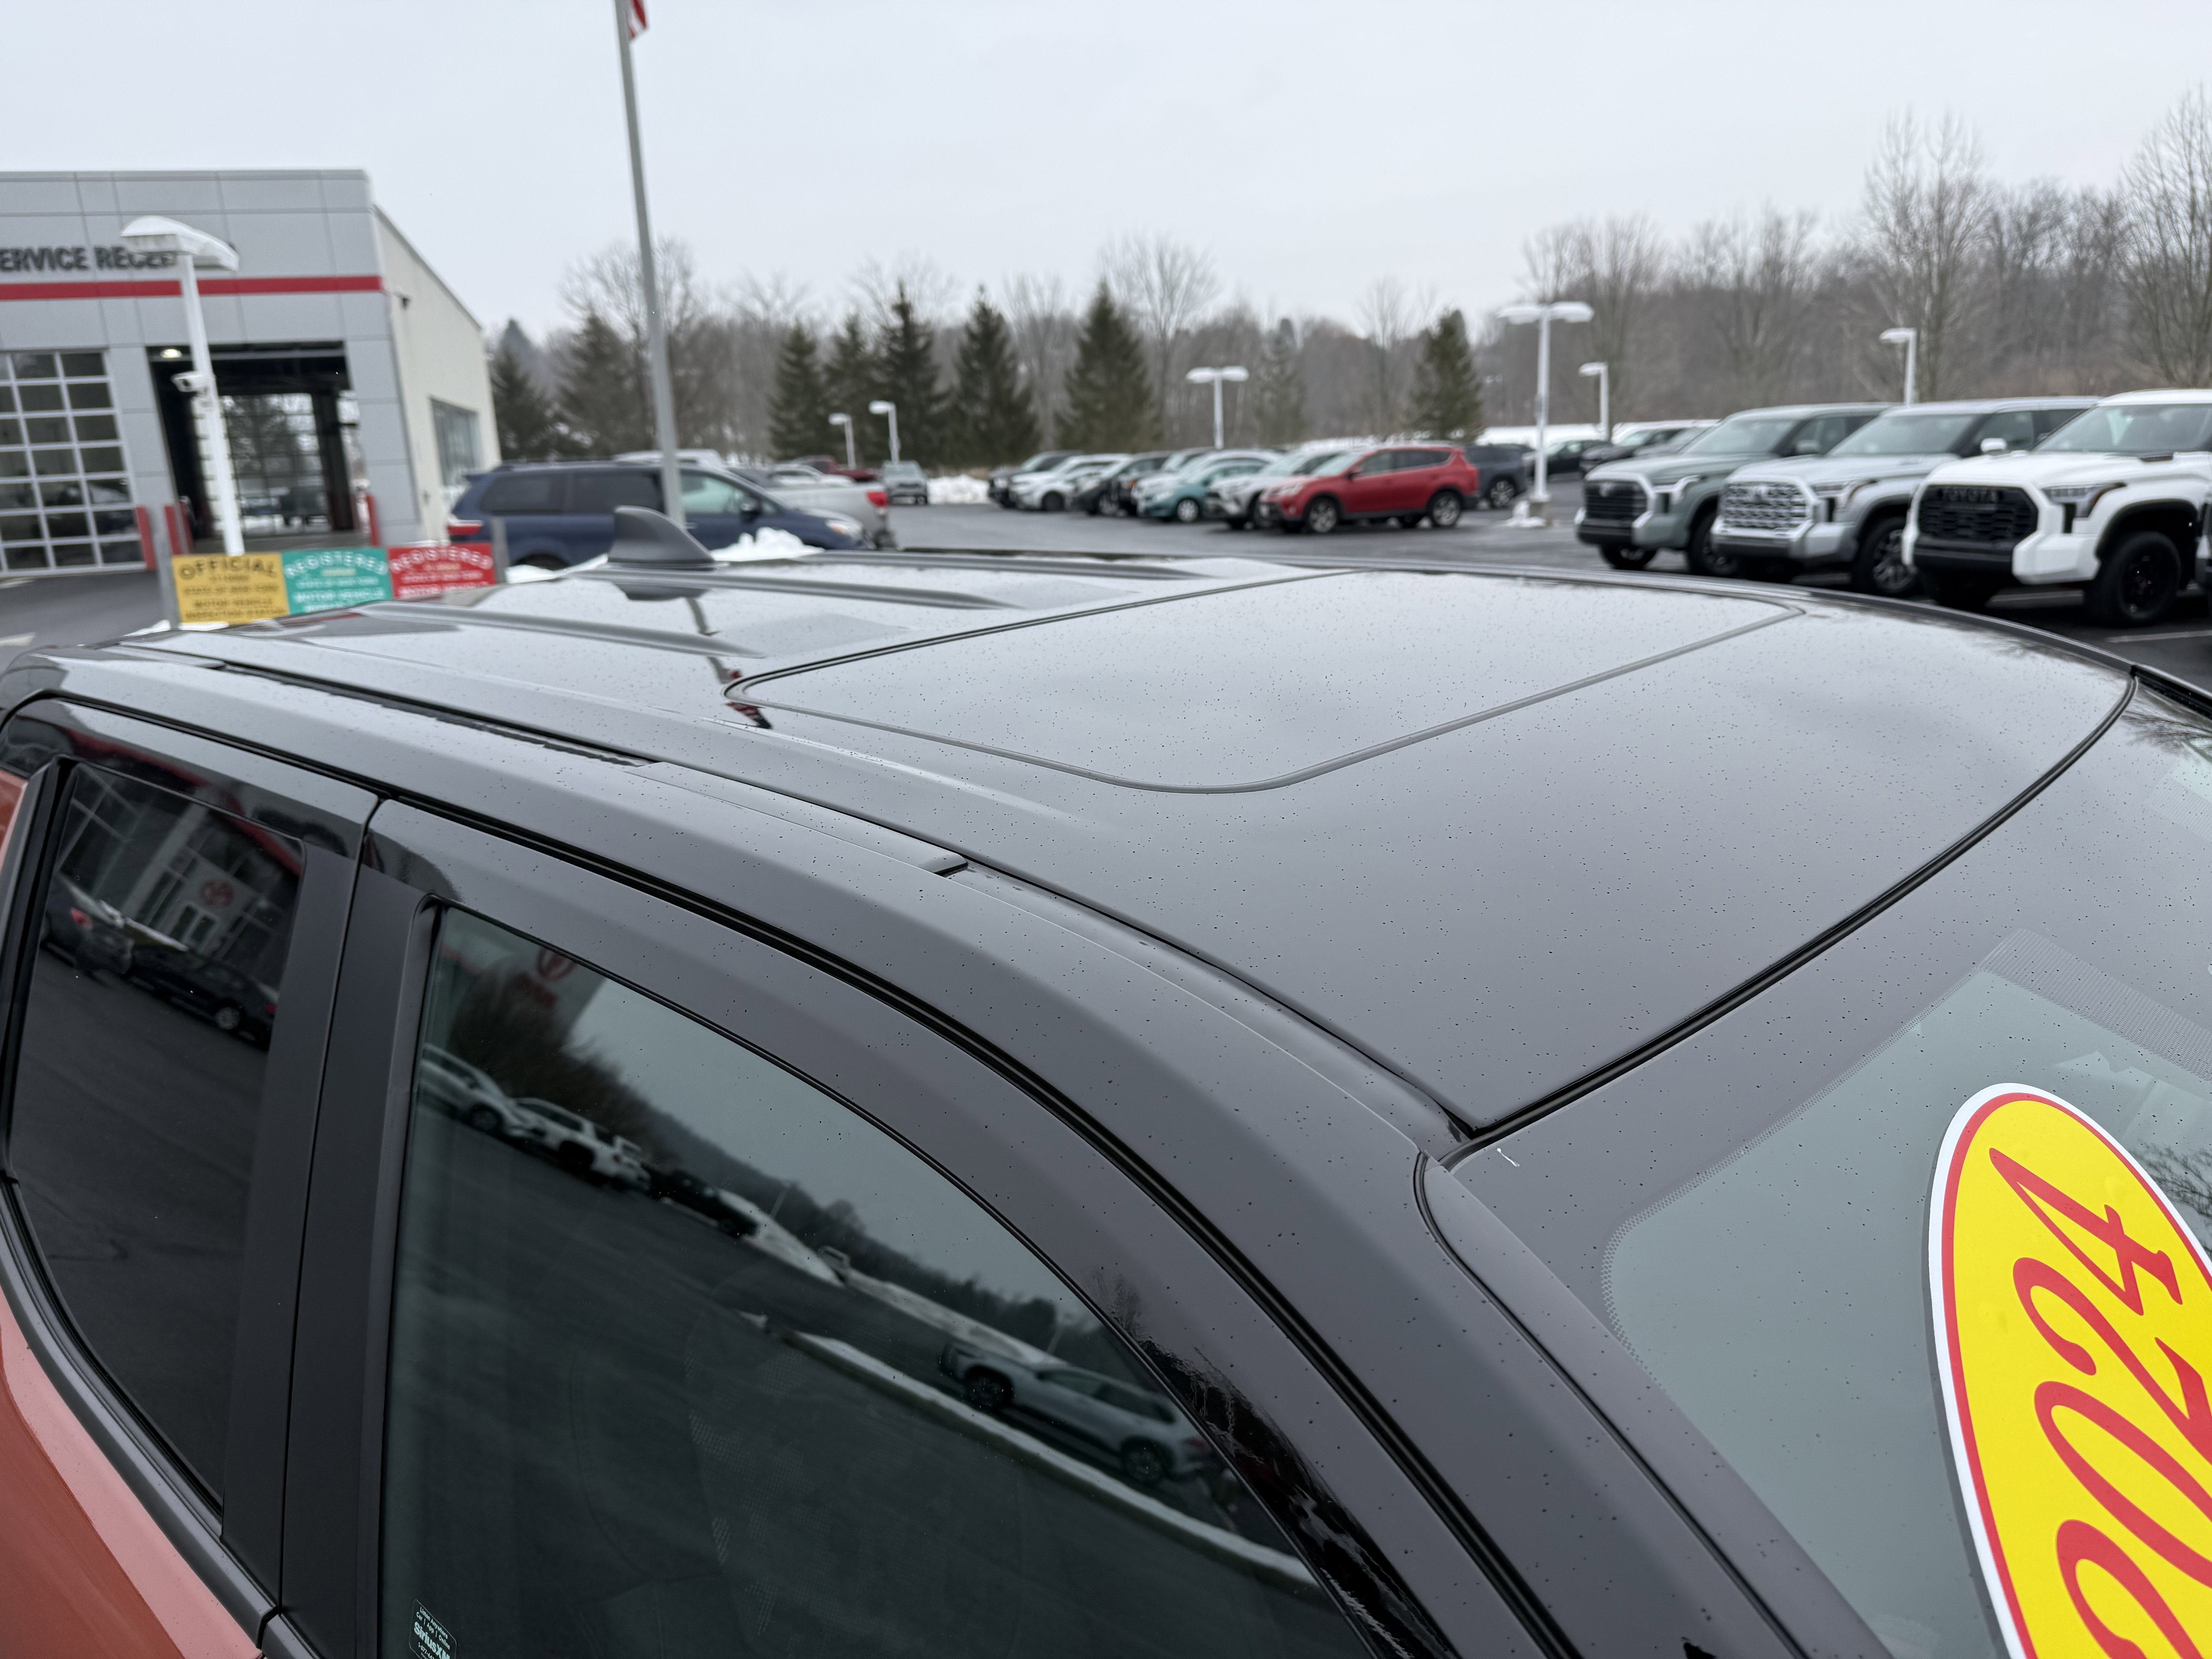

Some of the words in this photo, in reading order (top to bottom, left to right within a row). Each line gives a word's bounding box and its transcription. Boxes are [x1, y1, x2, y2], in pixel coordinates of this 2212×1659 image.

[179, 556, 278, 580] OFFICIAL
[284, 551, 388, 578] REGISTERED
[389, 545, 494, 574] REGISTERED
[414, 1621, 450, 1659] SiriusXM
